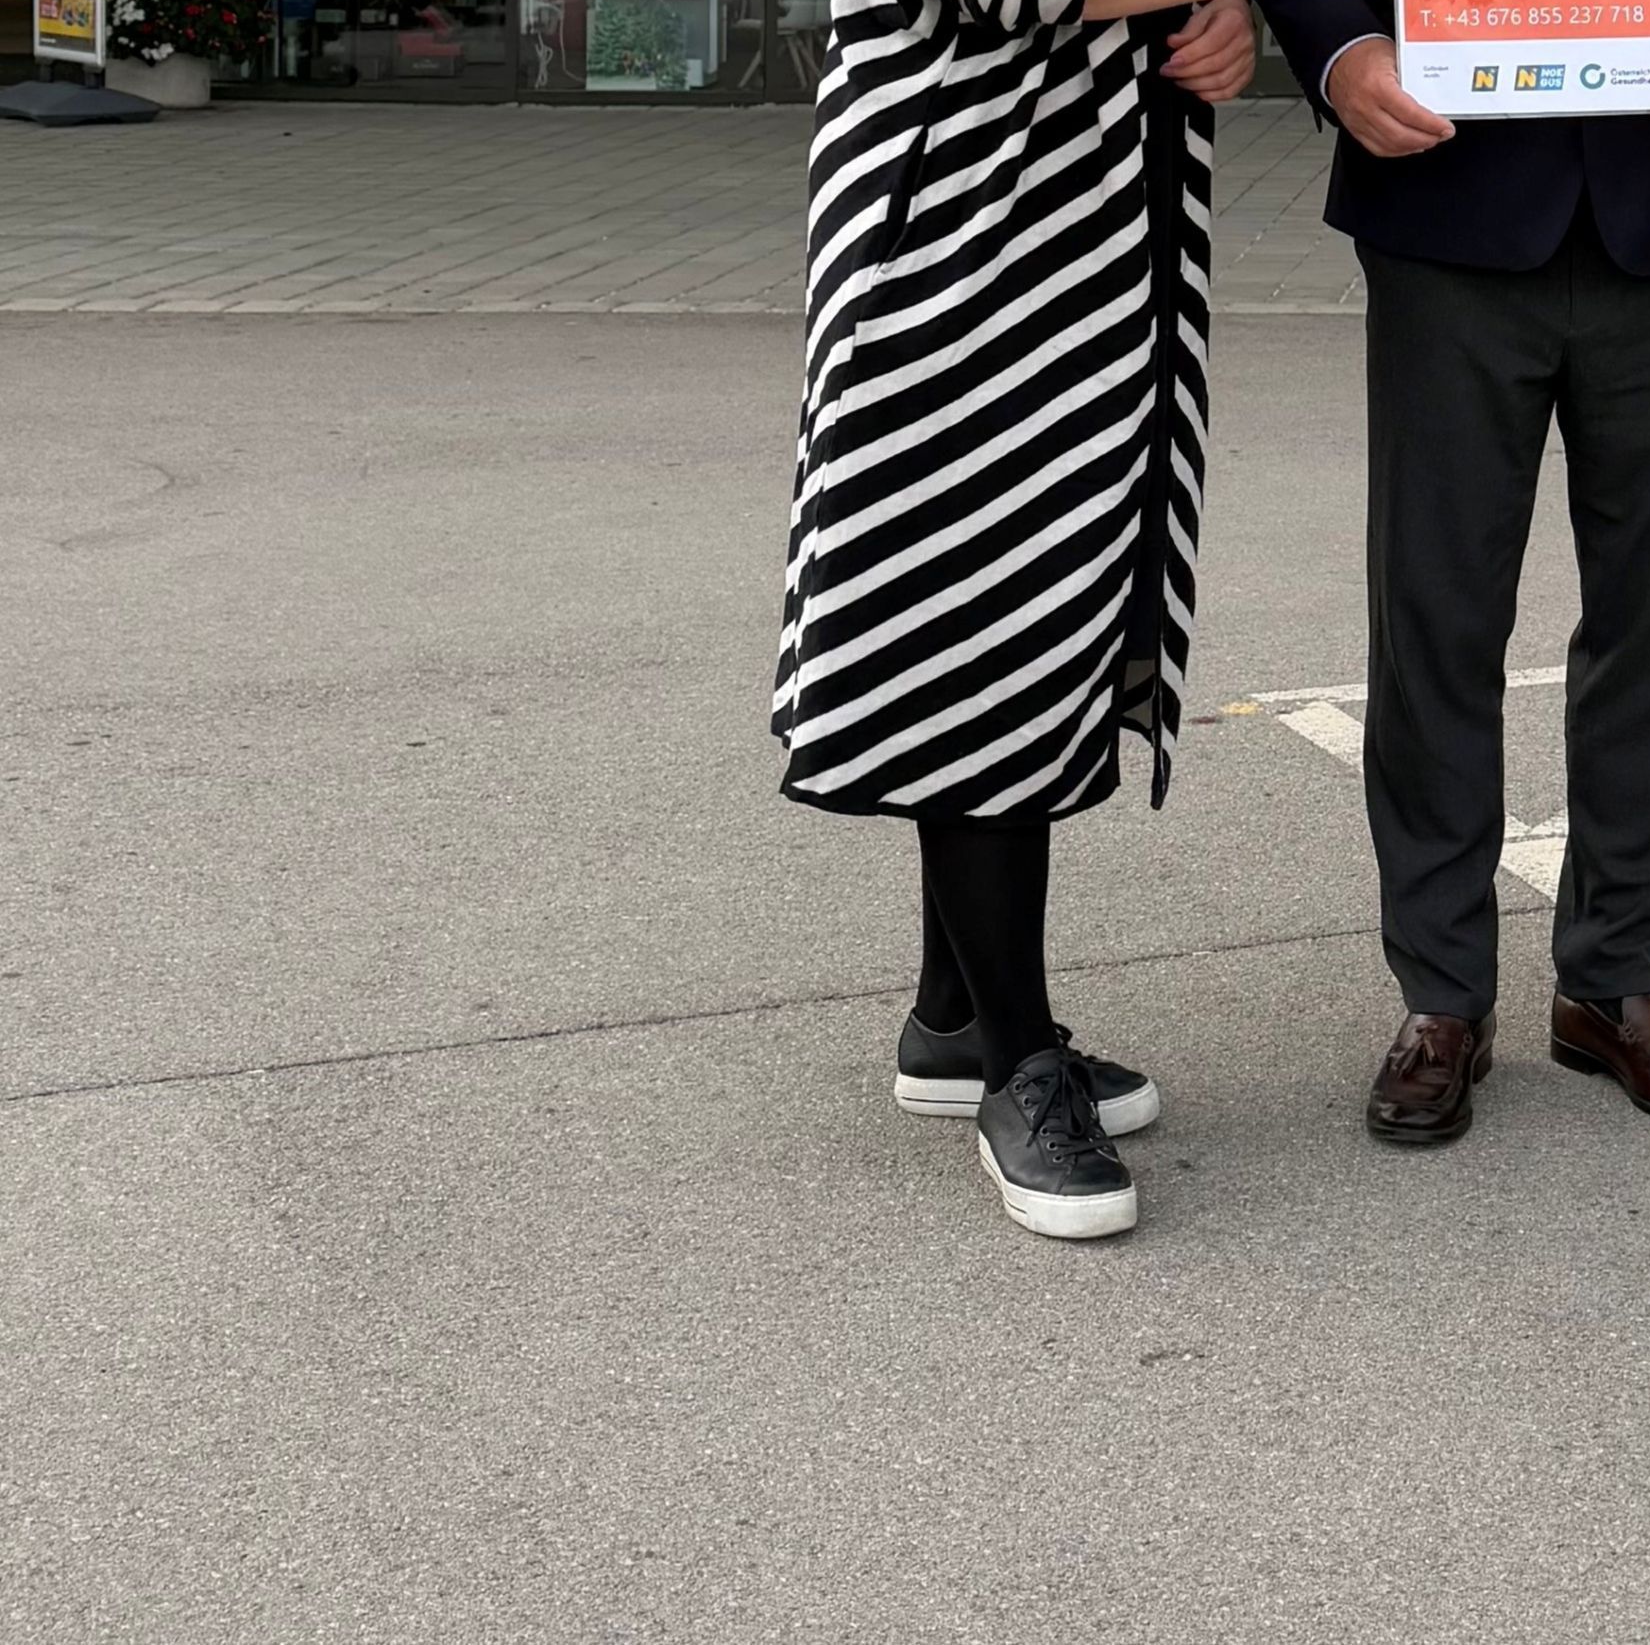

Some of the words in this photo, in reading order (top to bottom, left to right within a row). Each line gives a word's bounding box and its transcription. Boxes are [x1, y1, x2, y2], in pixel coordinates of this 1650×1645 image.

[1420, 10, 1437, 28] T:
[1444, 8, 1480, 27] +43
[1487, 7, 1522, 26] 676
[1528, 6, 1563, 25] 855
[1569, 5, 1604, 24] 237
[1610, 5, 1645, 23] 718
